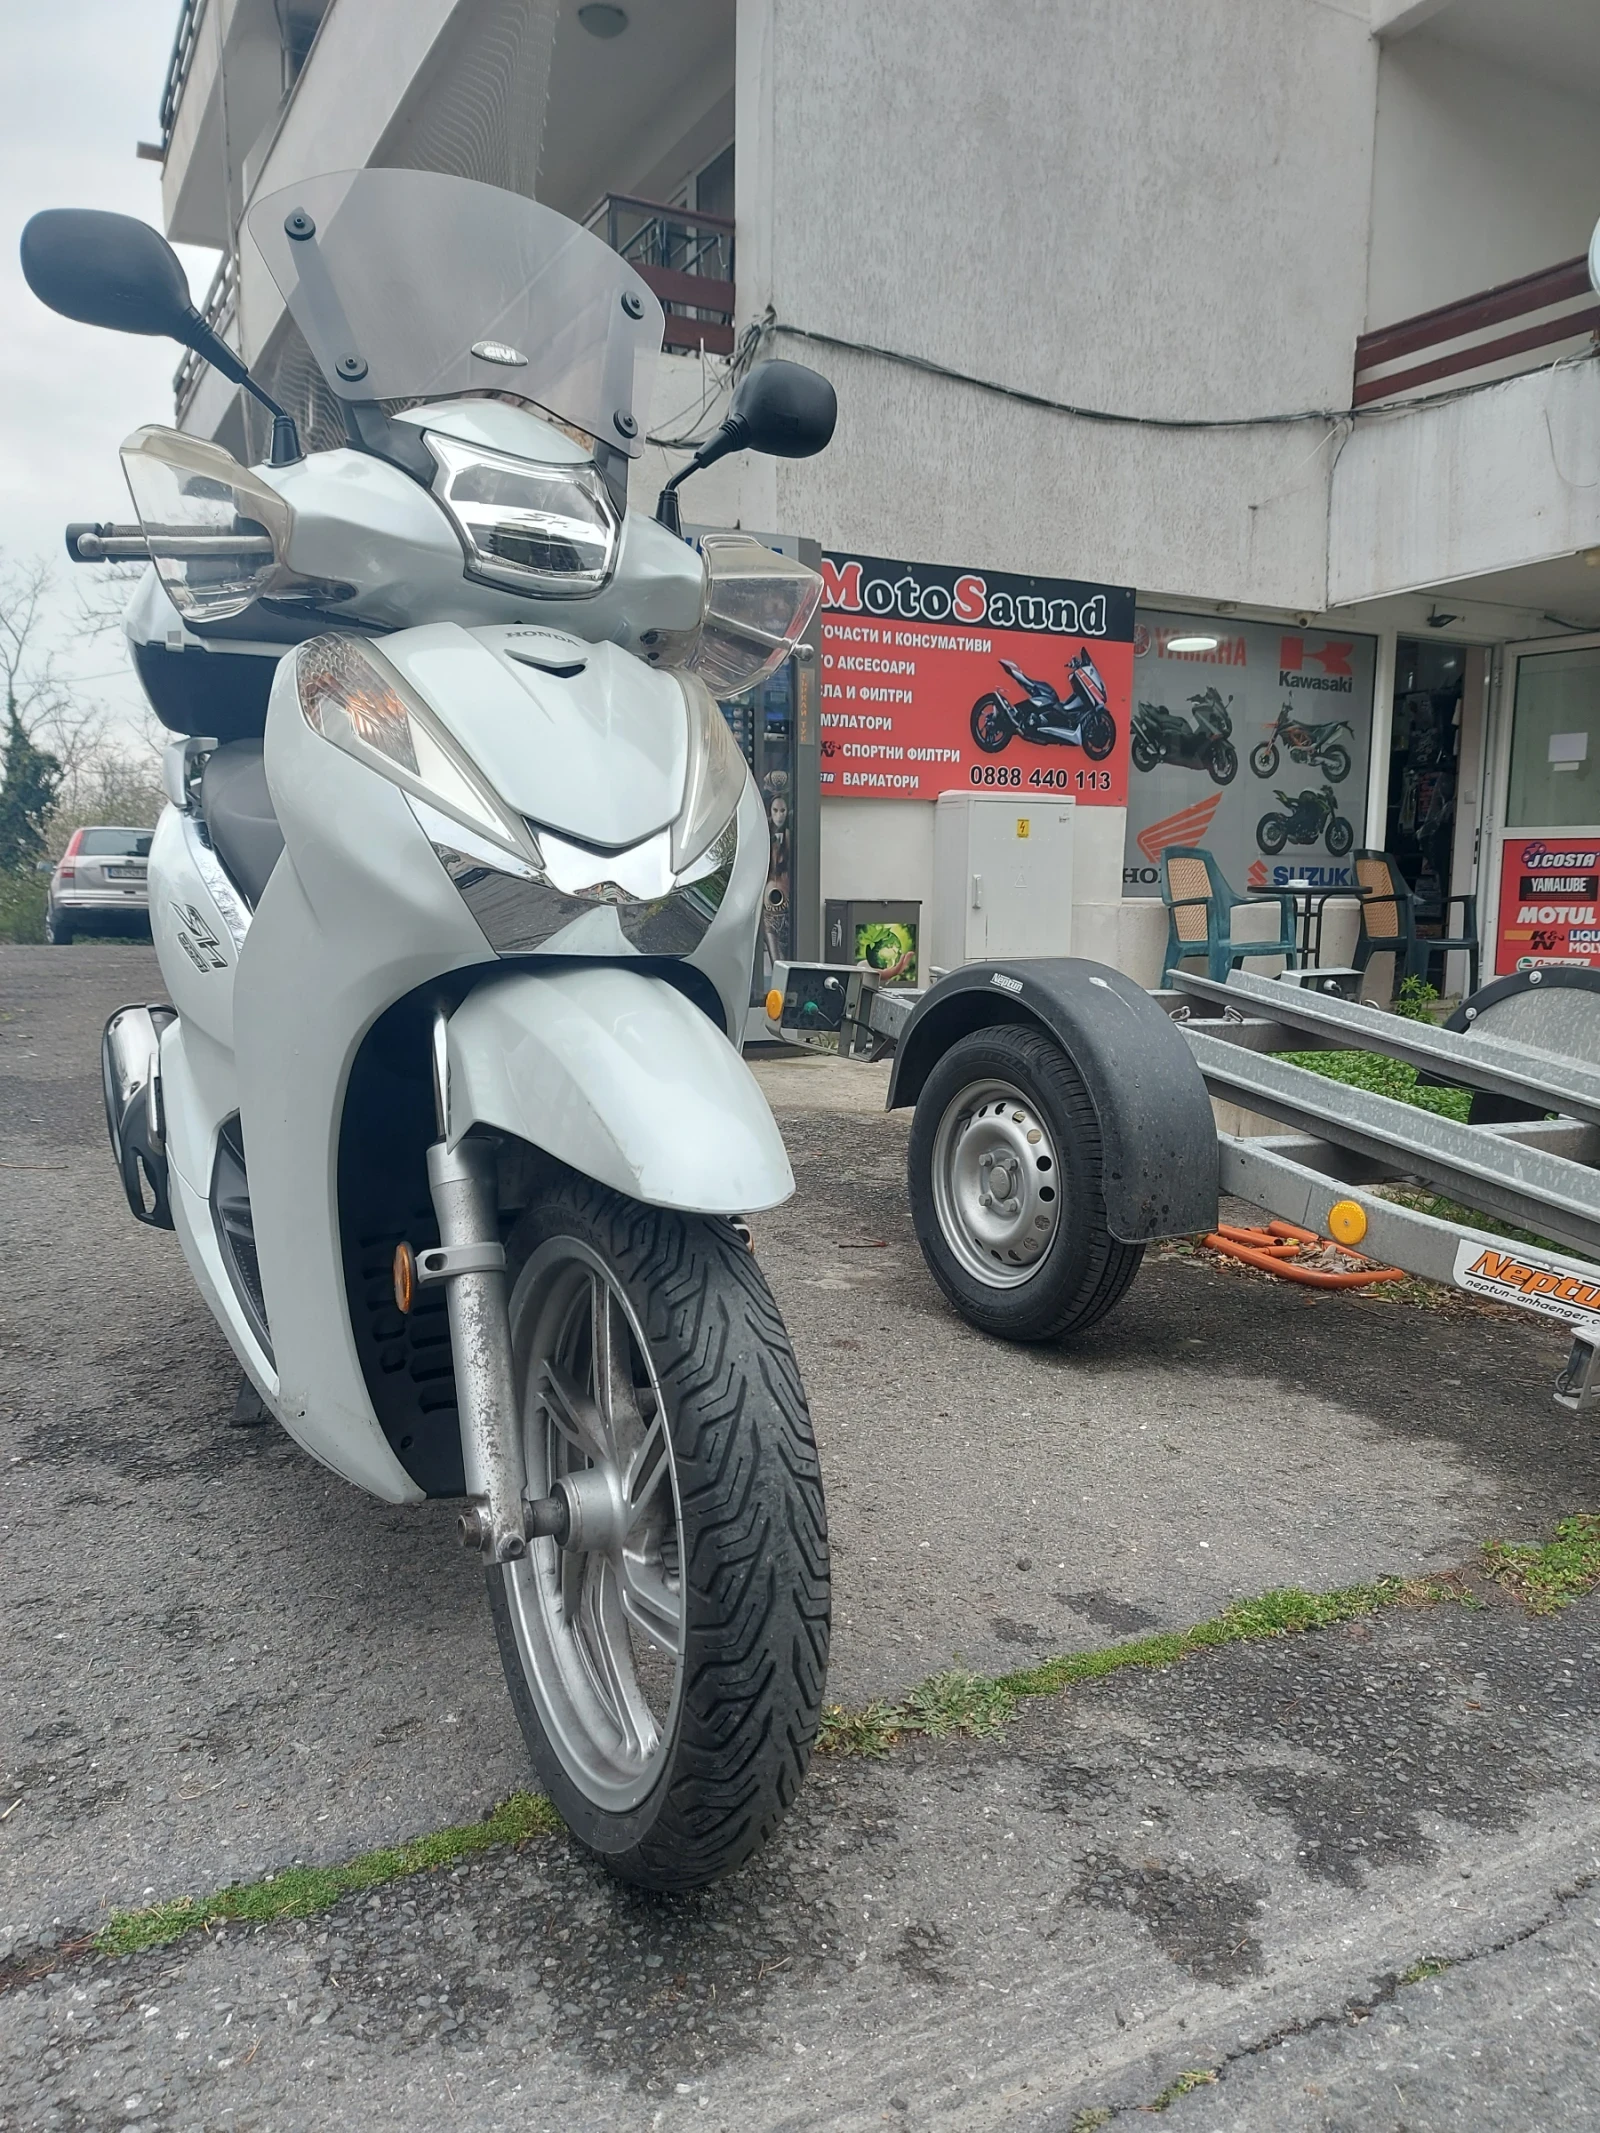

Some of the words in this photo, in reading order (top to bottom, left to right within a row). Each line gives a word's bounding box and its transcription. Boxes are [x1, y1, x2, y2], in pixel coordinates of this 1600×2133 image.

[483, 346, 517, 361] GIVI
[821, 558, 1107, 636] MotoSaund
[505, 630, 581, 648] HONDA
[821, 624, 879, 643] ОЧАСТИ
[882, 631, 892, 644] И
[895, 632, 992, 653] КОНСУМАТИВИ
[837, 655, 916, 676] АКСЕСОАРИ
[1279, 670, 1353, 693] Kawasaki
[821, 683, 842, 698] ЛА
[846, 686, 856, 699] И
[859, 687, 913, 704] ФИЛТРИ
[821, 713, 892, 731] МУЛАТОРИ
[843, 744, 904, 760] СПОРТНИ
[907, 749, 960, 763] ФИЛТРИ
[843, 772, 919, 789] ВАРИАТОРИ
[969, 765, 1022, 787] 0888
[1028, 768, 1068, 789] 440
[1075, 771, 1111, 791] 113
[1527, 853, 1597, 868] J.COSTA
[1273, 865, 1352, 886] SUZUK
[1531, 877, 1587, 892] YAMALUBE
[1516, 906, 1598, 925] MOTUL
[991, 972, 1024, 992] Neptun
